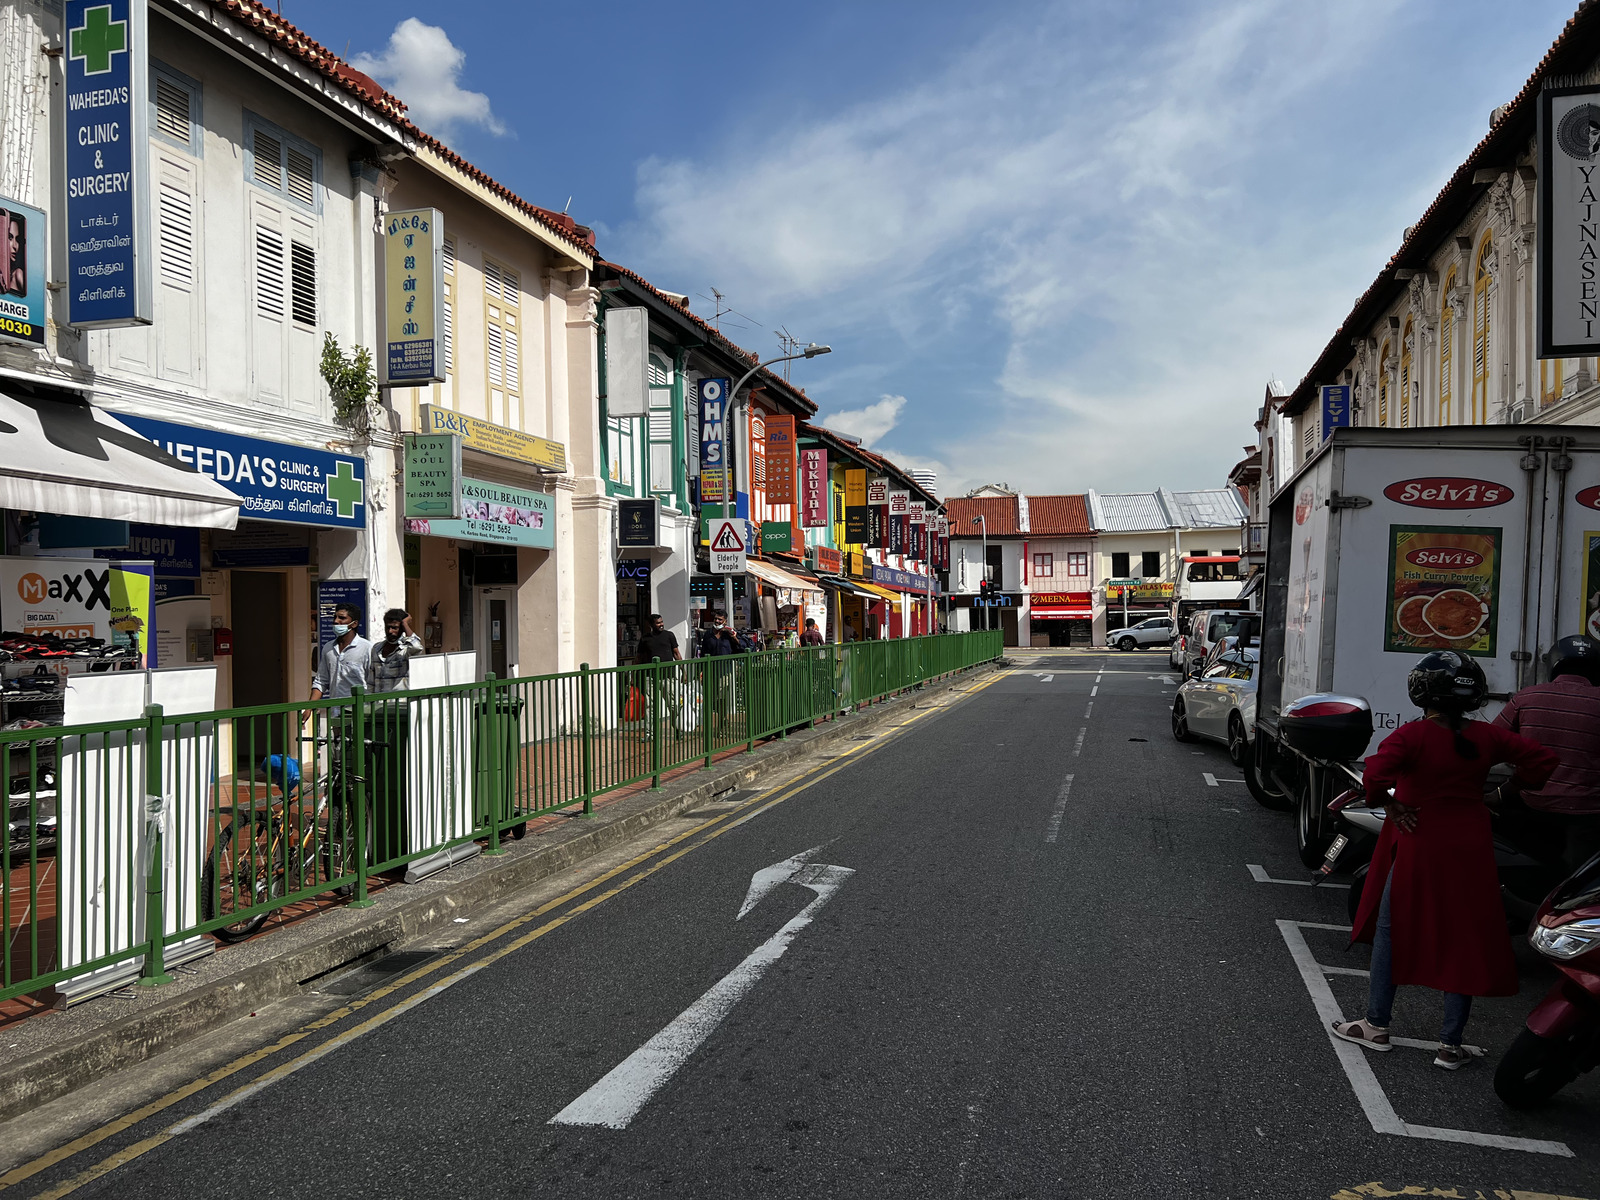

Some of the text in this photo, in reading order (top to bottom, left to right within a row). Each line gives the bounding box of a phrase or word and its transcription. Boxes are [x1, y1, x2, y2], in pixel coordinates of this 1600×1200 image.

[69, 87, 128, 111] WAHEEDA'S
[78, 122, 119, 146] CLINIC
[94, 150, 104, 169] &
[69, 172, 130, 197] SURGERY
[81, 213, 120, 228] டாக்டர்
[1577, 165, 1599, 338] YAJNASENI
[432, 410, 471, 437] B&K
[702, 381, 723, 462] OHMS
[473, 421, 512, 437] EMPLOYMENT
[514, 433, 536, 444] AGENCY
[770, 430, 788, 441] Ria
[412, 442, 445, 450] BODY
[279, 459, 311, 476] CLINIC
[313, 465, 320, 478] &
[280, 477, 325, 495] SURGERY
[806, 451, 820, 518] MUKUTHI
[1400, 482, 1499, 502] Selvi's
[501, 492, 532, 507] BEAUTY
[533, 499, 548, 510] SPA
[497, 525, 511, 534] 5652
[717, 554, 739, 563] Elderly
[1415, 551, 1474, 564] Selvi's
[1403, 571, 1484, 582] Fish Curry Powder
[1040, 595, 1070, 603] MEENA
